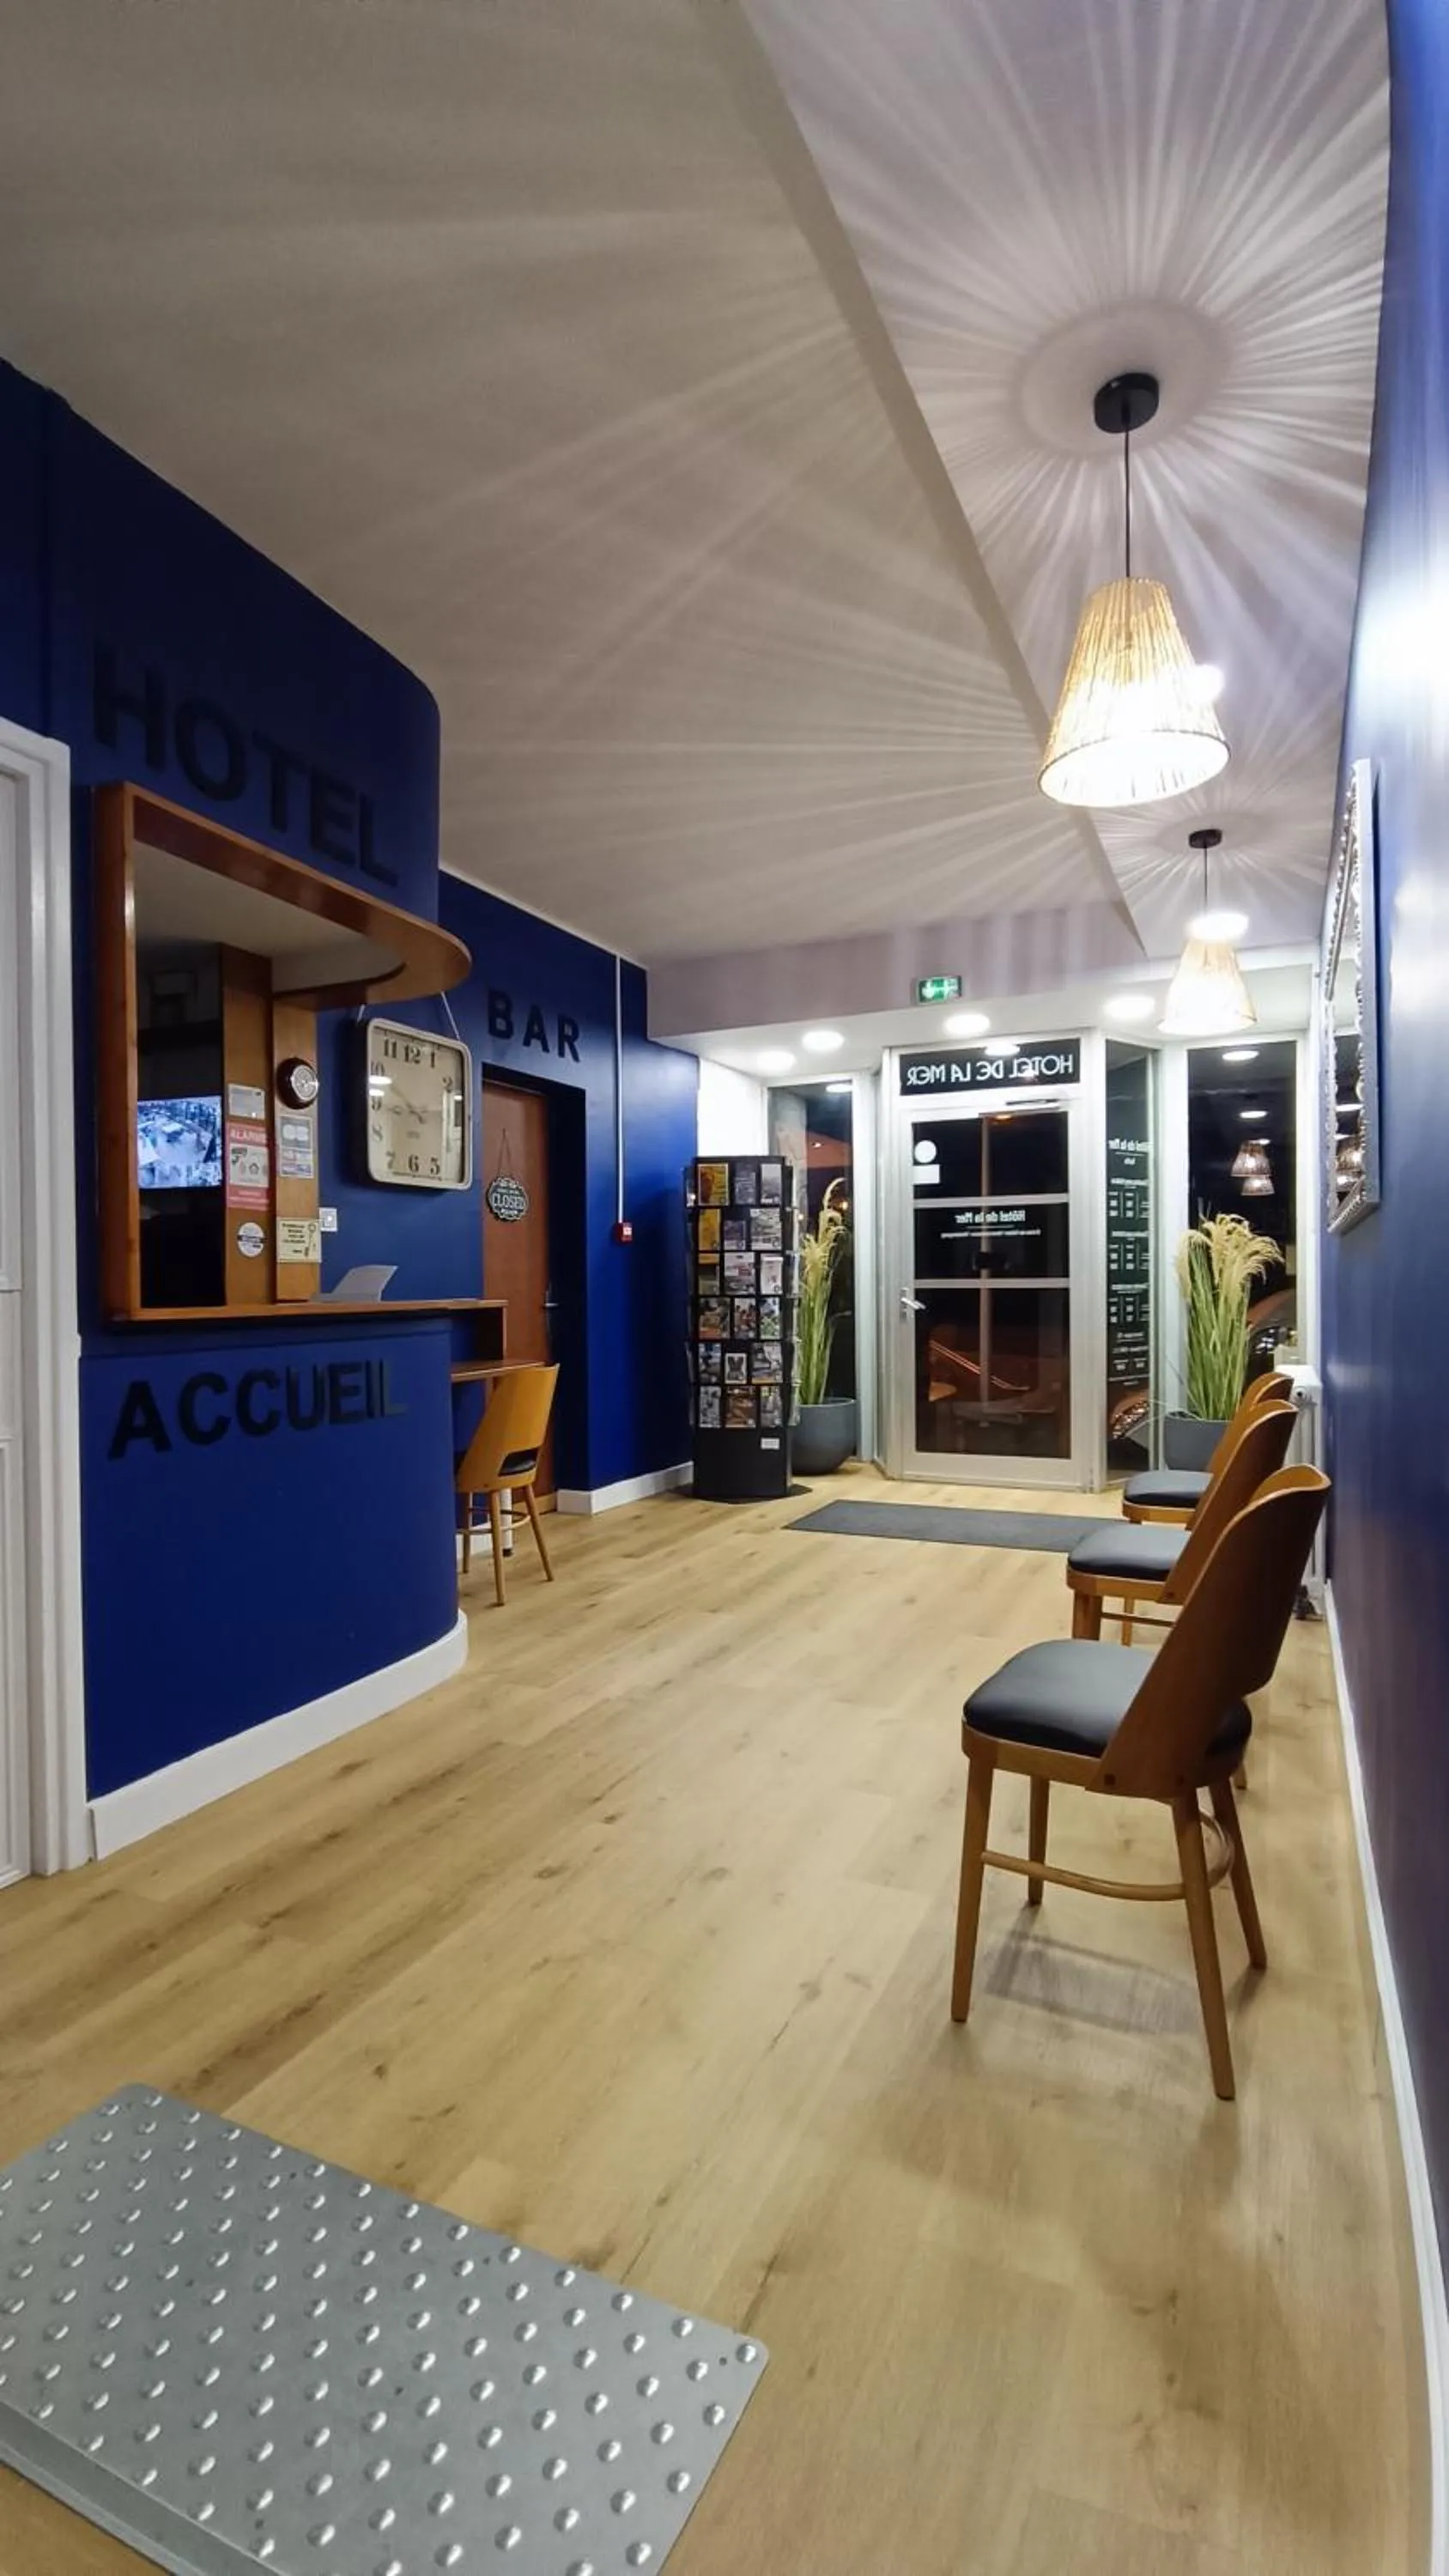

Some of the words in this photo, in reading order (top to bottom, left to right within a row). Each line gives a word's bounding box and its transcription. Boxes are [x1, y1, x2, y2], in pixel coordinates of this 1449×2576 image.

[93, 639, 397, 886] HOTEL
[403, 1044, 421, 1065] 12
[488, 988, 580, 1062] BAR
[408, 1153, 420, 1174] 6
[107, 1356, 409, 1462] ACCUEIL
